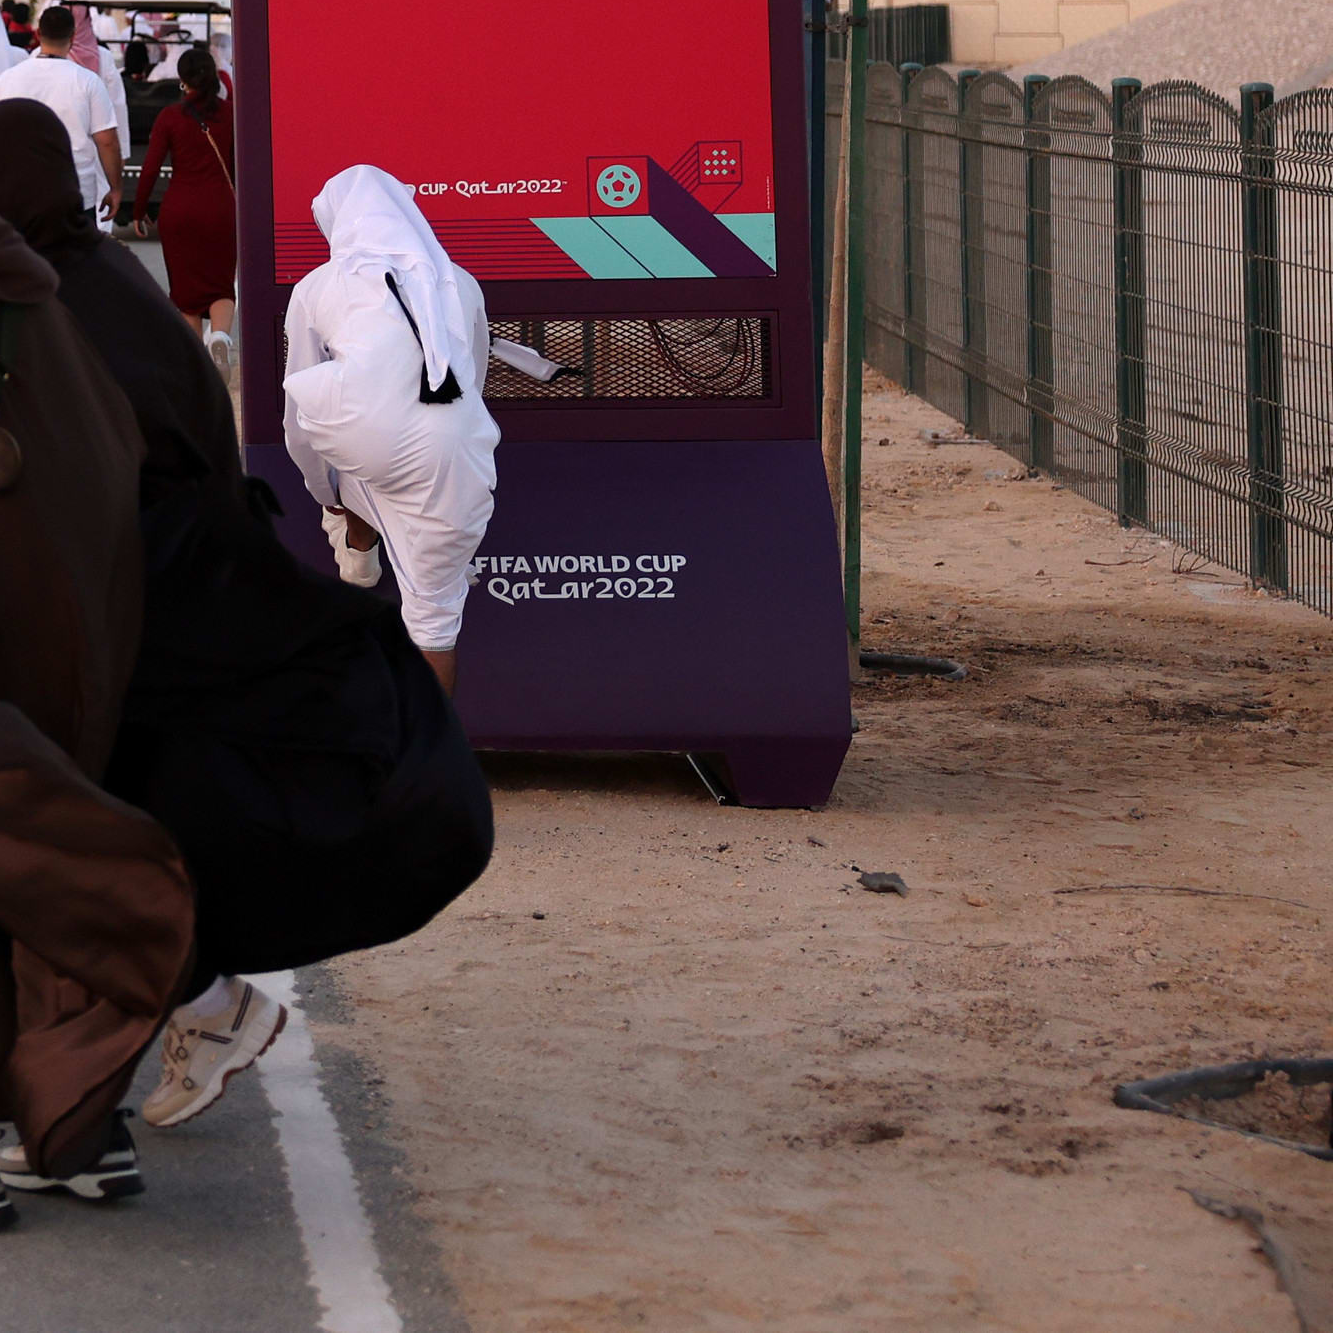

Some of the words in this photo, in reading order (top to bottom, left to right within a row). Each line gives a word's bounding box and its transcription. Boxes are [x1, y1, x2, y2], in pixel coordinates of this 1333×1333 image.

[418, 183, 448, 195] CUP
[475, 556, 532, 574] FIFA
[533, 555, 631, 573] WORLD
[635, 555, 687, 573] CUP
